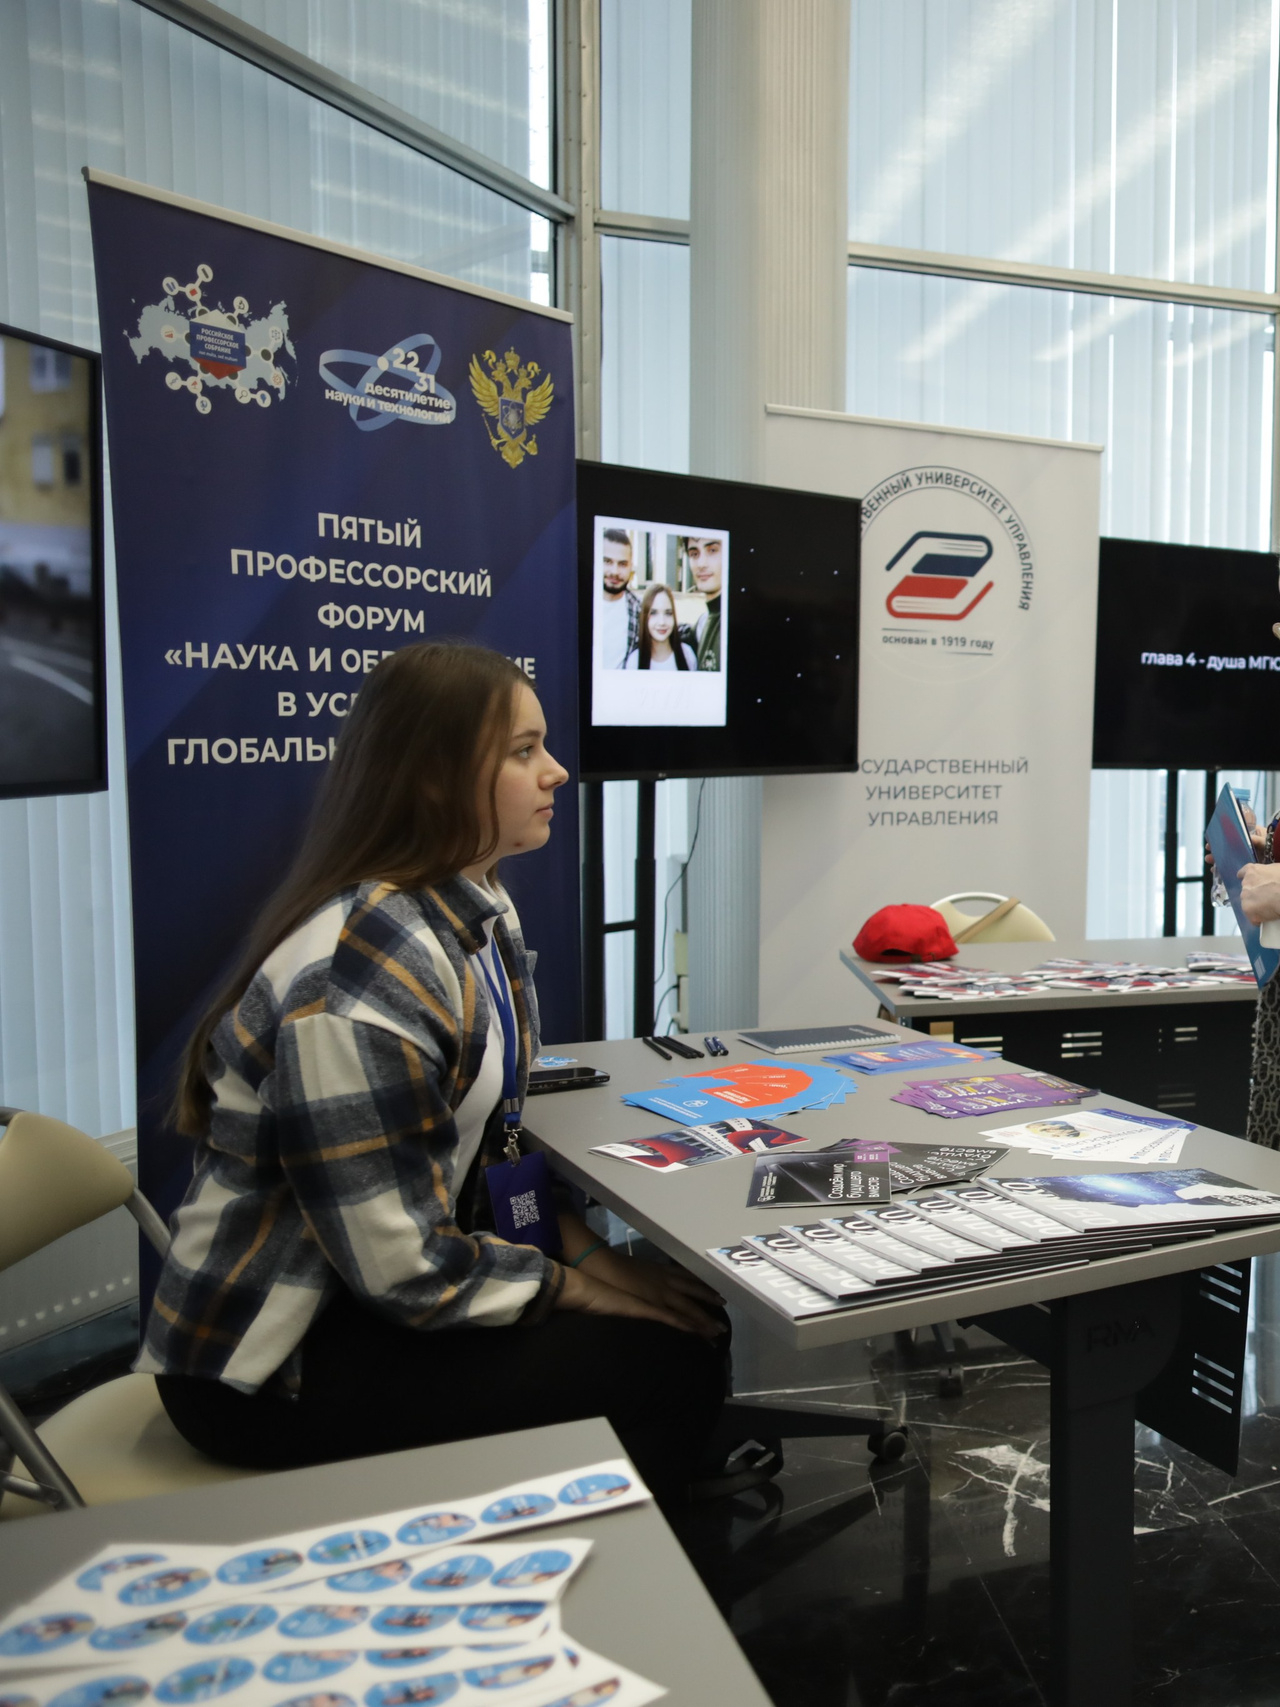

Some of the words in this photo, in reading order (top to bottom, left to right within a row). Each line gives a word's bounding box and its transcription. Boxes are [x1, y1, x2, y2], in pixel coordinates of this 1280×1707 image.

[392, 347, 421, 373] 22
[414, 371, 436, 394] 31
[324, 389, 366, 407] науки
[366, 398, 376, 409] и
[377, 400, 451, 425] технологий
[364, 382, 451, 410] десятилетие
[317, 511, 422, 549] ПЯТЫЙ
[914, 471, 1007, 515] УНИВЕРСИТЕТ
[1004, 514, 1034, 611] УПРАВЛЕНИЯ
[230, 548, 492, 598] ПРОФЕССОРСКИЙ
[317, 602, 425, 633] ФОРУМ
[882, 635, 927, 646] основан
[931, 638, 937, 646] в
[941, 636, 966, 647] 1919
[970, 639, 994, 651] году
[164, 641, 299, 672] «НАУКА
[308, 646, 332, 672] И
[1140, 651, 1184, 667] глава
[1185, 652, 1197, 667] 4
[1206, 655, 1247, 672] душа
[277, 691, 298, 717] В
[860, 755, 1029, 777] СУДАРСТВЕННЫЙ
[865, 784, 1003, 801] УНИВЕРСИТЕТ
[868, 810, 999, 827] УПРАВЛЕНИЯ
